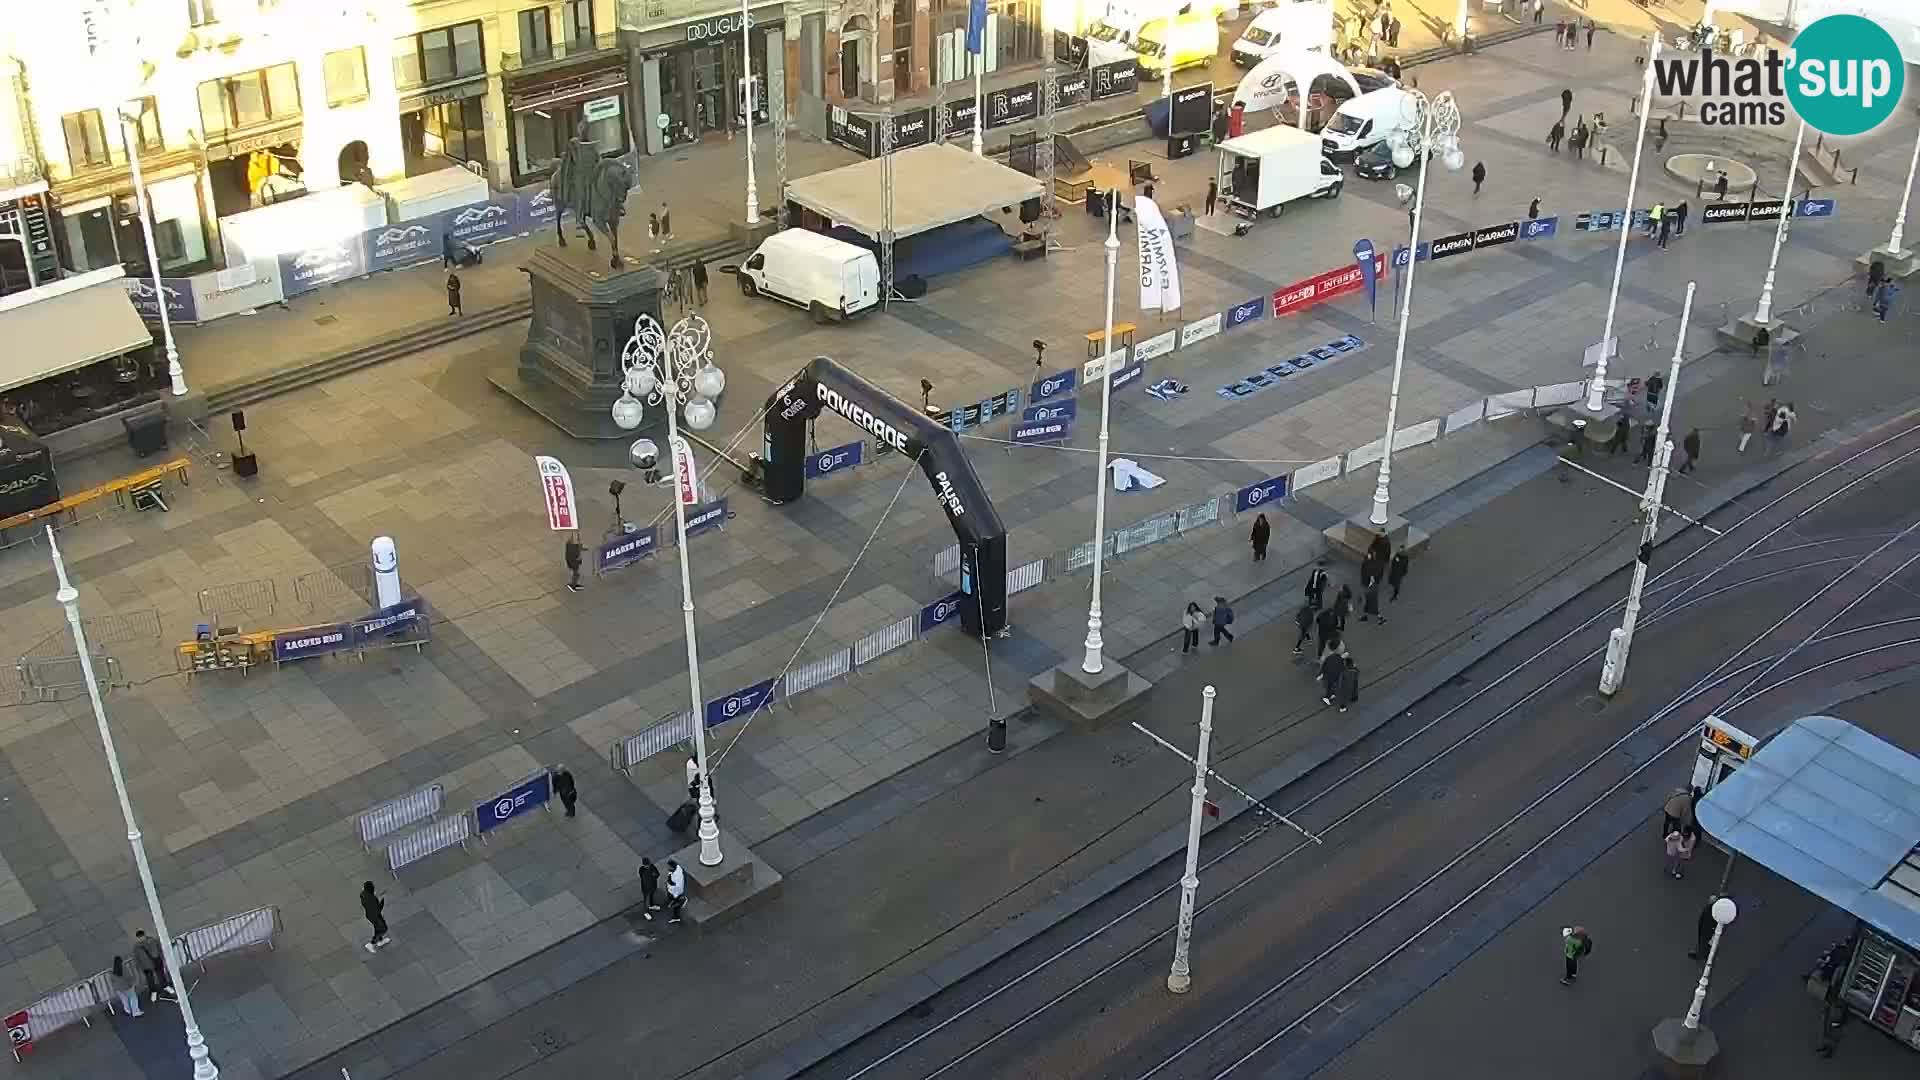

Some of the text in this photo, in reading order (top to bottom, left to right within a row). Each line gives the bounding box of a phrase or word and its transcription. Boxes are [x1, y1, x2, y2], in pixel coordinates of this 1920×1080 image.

[688, 13, 754, 40] DOUGLAS
[1433, 236, 1473, 254] GARMIN
[1476, 227, 1516, 243] GARMIN
[816, 381, 909, 454] POWERADE
[935, 471, 965, 517] PAUSE
[605, 535, 652, 559] ZAGREB RUN
